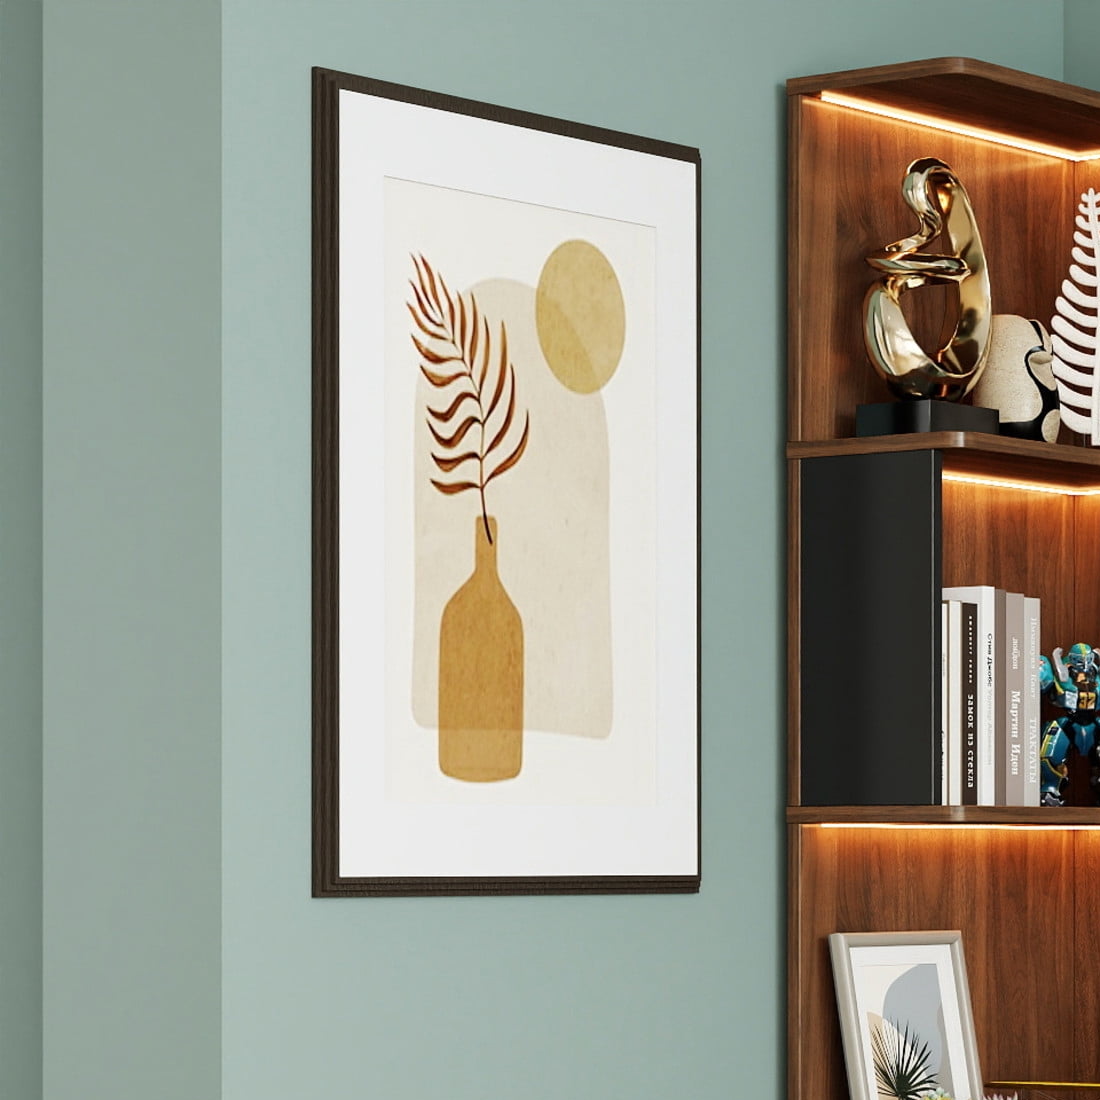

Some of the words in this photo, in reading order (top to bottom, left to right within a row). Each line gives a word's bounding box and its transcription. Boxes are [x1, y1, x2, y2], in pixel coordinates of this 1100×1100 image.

[1078, 692, 1096, 710] 32
[1010, 691, 1020, 738] Мартин
[968, 733, 974, 746] из
[1011, 744, 1020, 775] Иден
